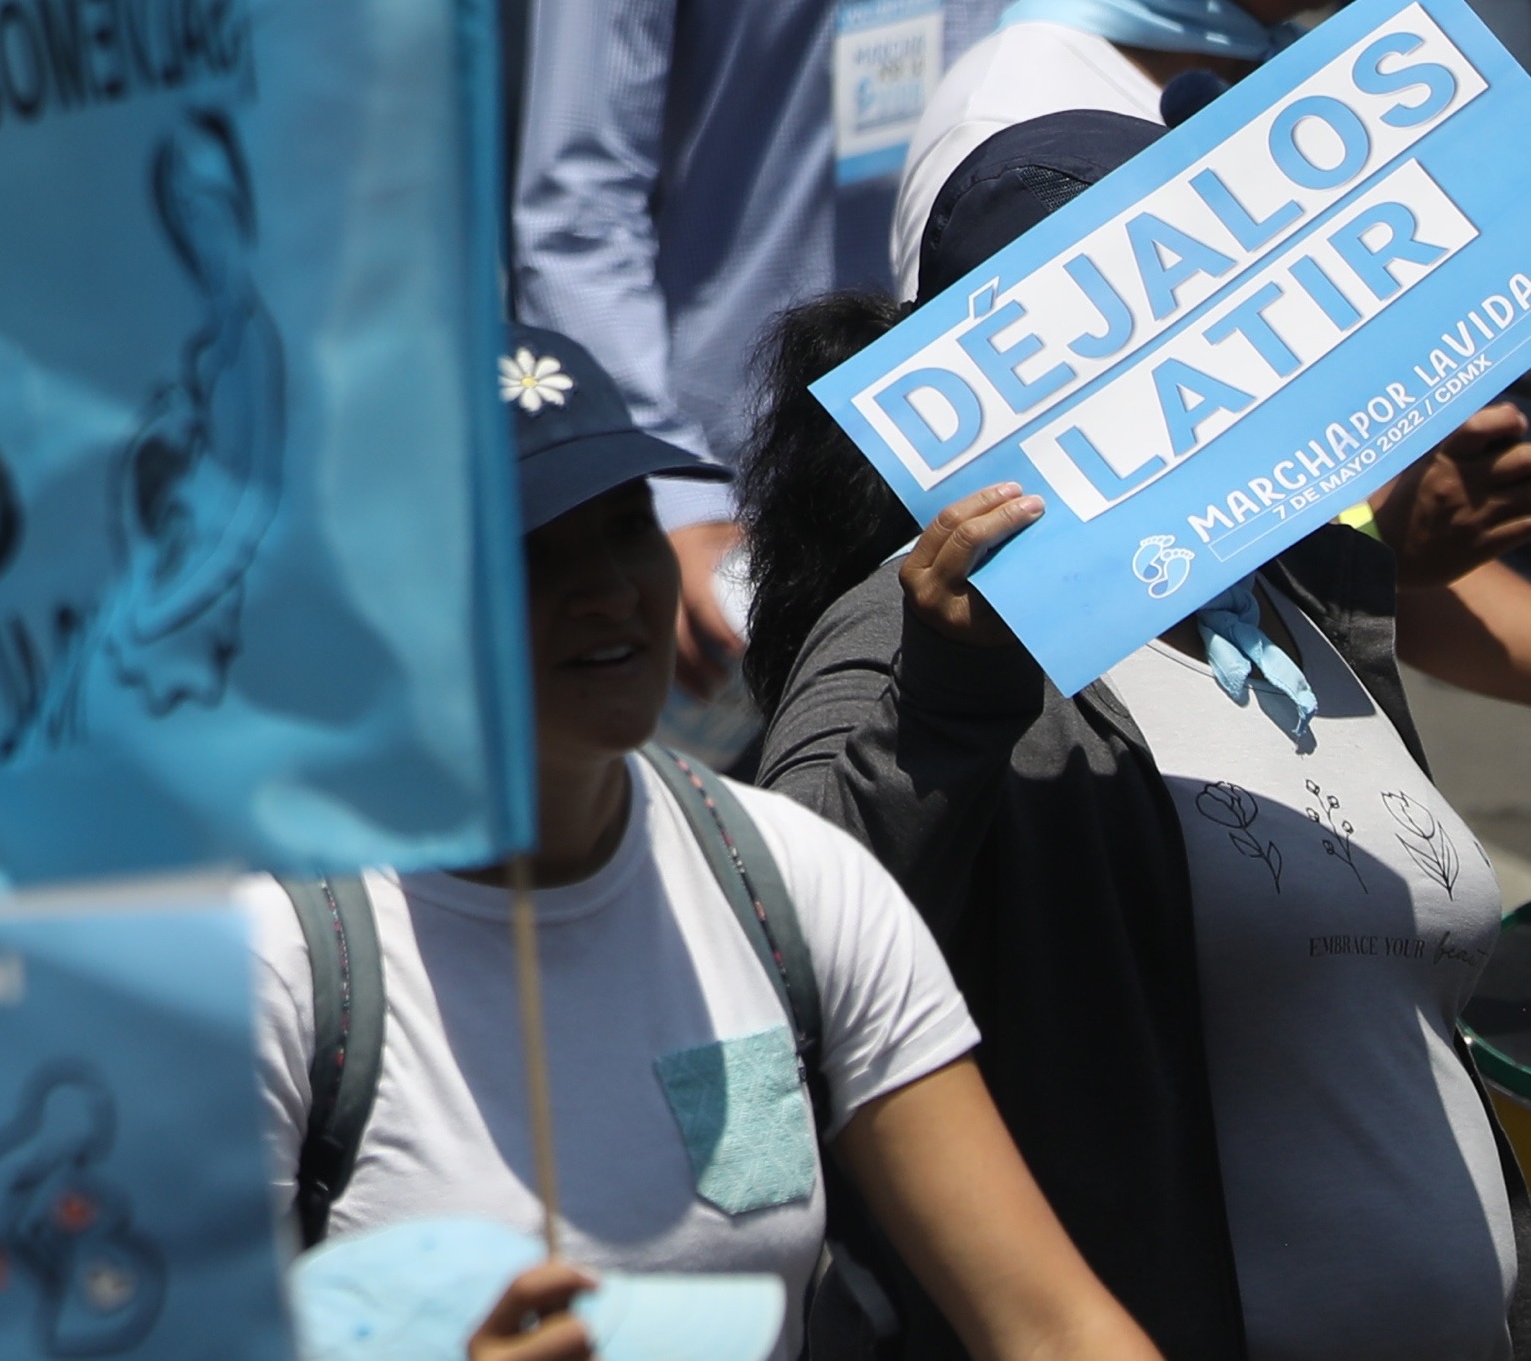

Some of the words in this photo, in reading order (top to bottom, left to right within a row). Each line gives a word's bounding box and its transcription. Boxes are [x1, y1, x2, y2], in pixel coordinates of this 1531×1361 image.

[872, 31, 1458, 472] DÉJALOS
[1055, 200, 1451, 503] LATIR
[1272, 505, 1287, 521] 7
[1289, 487, 1320, 511] DE
[1322, 447, 1377, 492] MAYO
[1376, 411, 1425, 453] 2022
[1437, 352, 1494, 404] CDMX
[1309, 934, 1379, 958] EMBRACE
[1384, 936, 1425, 958] YOUR
